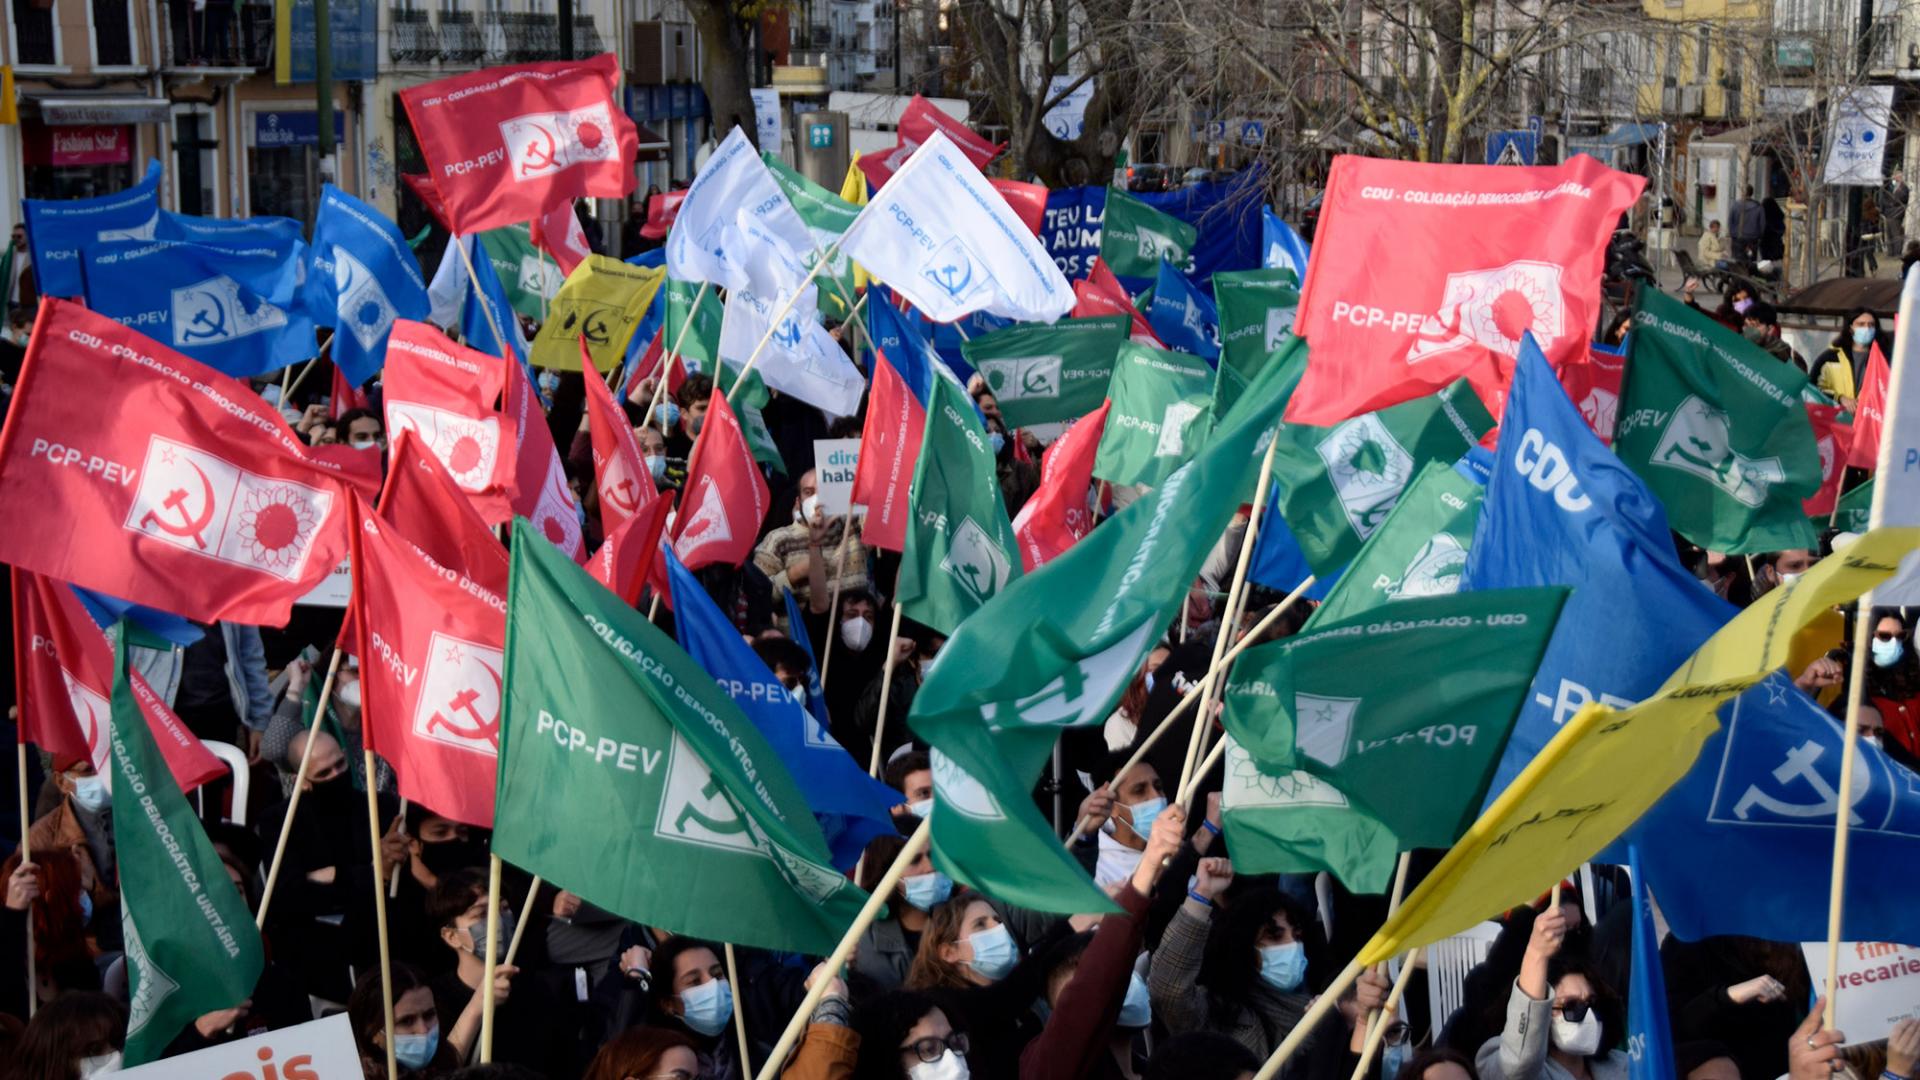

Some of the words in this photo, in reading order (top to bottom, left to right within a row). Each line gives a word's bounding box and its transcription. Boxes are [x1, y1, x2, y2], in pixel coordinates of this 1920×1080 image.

[444, 147, 504, 177] PCP-PEV
[1046, 205, 1081, 229] TEU
[1361, 186, 1394, 200] CDU
[1404, 190, 1477, 207] COLIGAÇÃO
[889, 202, 936, 252] PCP-PEV
[69, 329, 103, 350] CDU
[111, 343, 191, 386] COLIGAÇÃO
[192, 380, 282, 439] DEMOCRÁTICA
[944, 404, 963, 426] CDU
[31, 437, 137, 487] PCP-PEV
[1515, 428, 1592, 513] CDU
[1440, 492, 1467, 511] CDU
[584, 613, 674, 688] COLIGAÇÃO
[537, 708, 662, 775] PCP-PEV
[140, 795, 200, 894] DEMOCRÁTICA
[196, 893, 241, 959] UNITÁRIA
